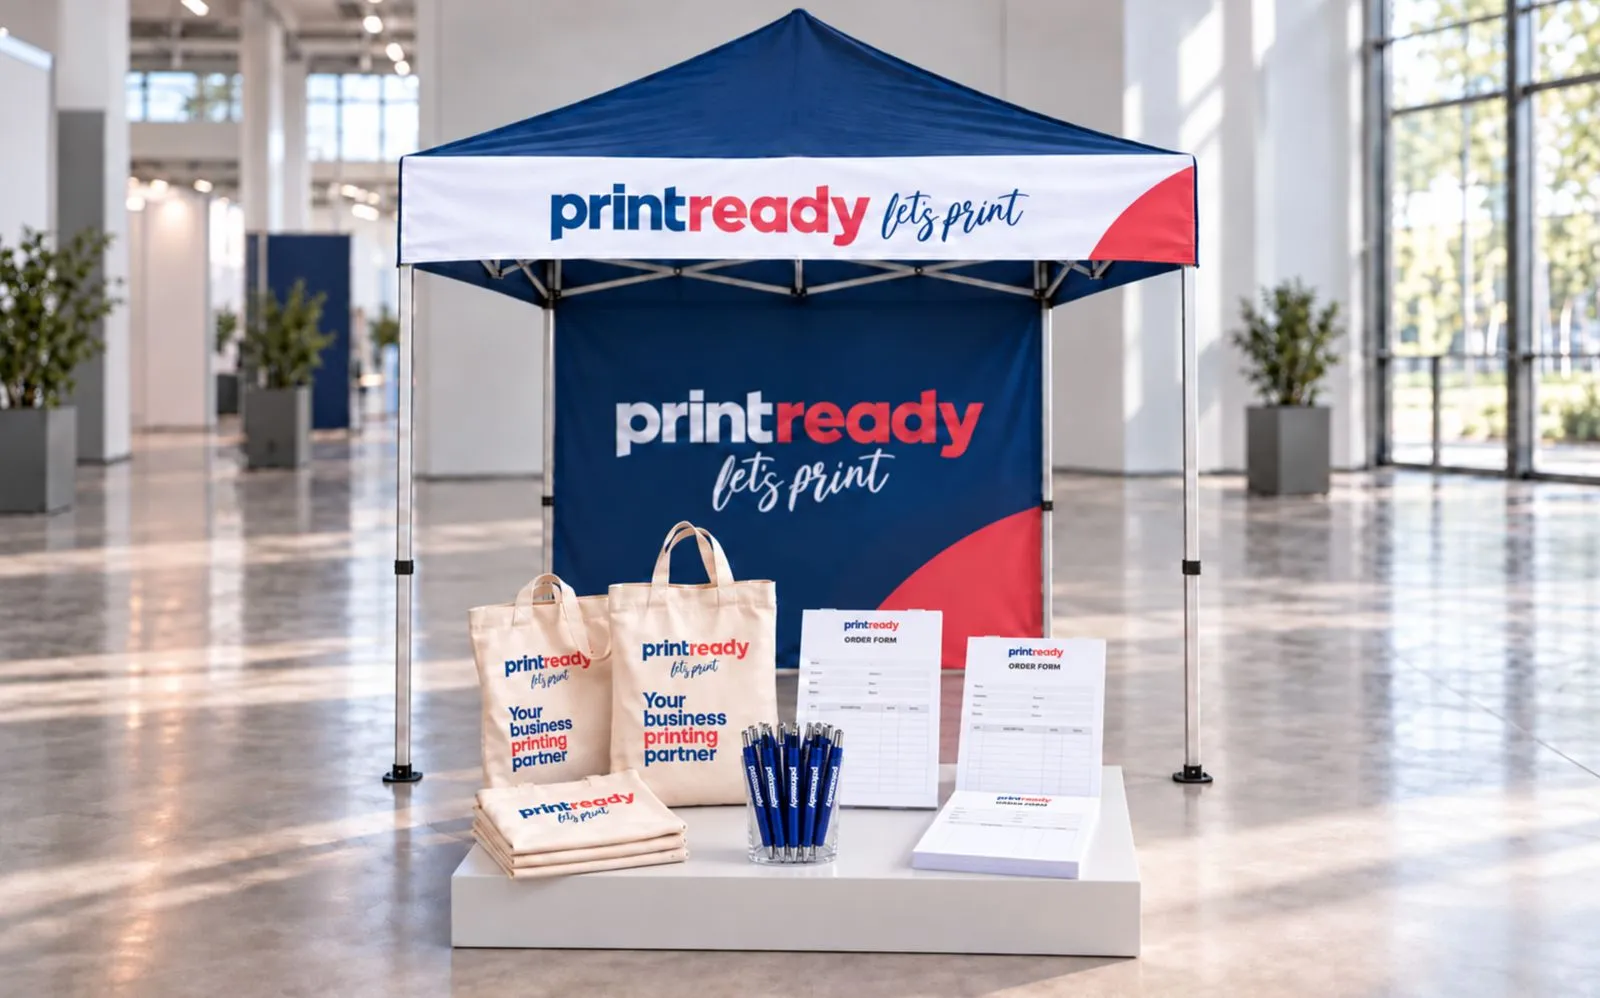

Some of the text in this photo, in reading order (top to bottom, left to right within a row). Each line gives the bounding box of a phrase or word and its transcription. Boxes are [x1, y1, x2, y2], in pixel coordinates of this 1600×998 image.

[551, 183, 1030, 246] printready let's print
[615, 389, 984, 458] printready
[712, 448, 896, 513] let's print
[844, 620, 899, 632] printready
[642, 638, 750, 661] printready
[844, 636, 897, 644] ORDER FORM
[1008, 646, 1064, 658] printready
[505, 650, 591, 677] printready
[690, 658, 720, 679] print
[1008, 662, 1036, 670] ORDER
[642, 691, 686, 709] Your
[508, 706, 543, 721] Your
[643, 709, 727, 727] business
[510, 719, 573, 738] business
[643, 727, 718, 749] printing
[511, 734, 567, 757] printing
[512, 750, 568, 772] partner
[644, 746, 717, 767] partner
[518, 792, 634, 819] printready
